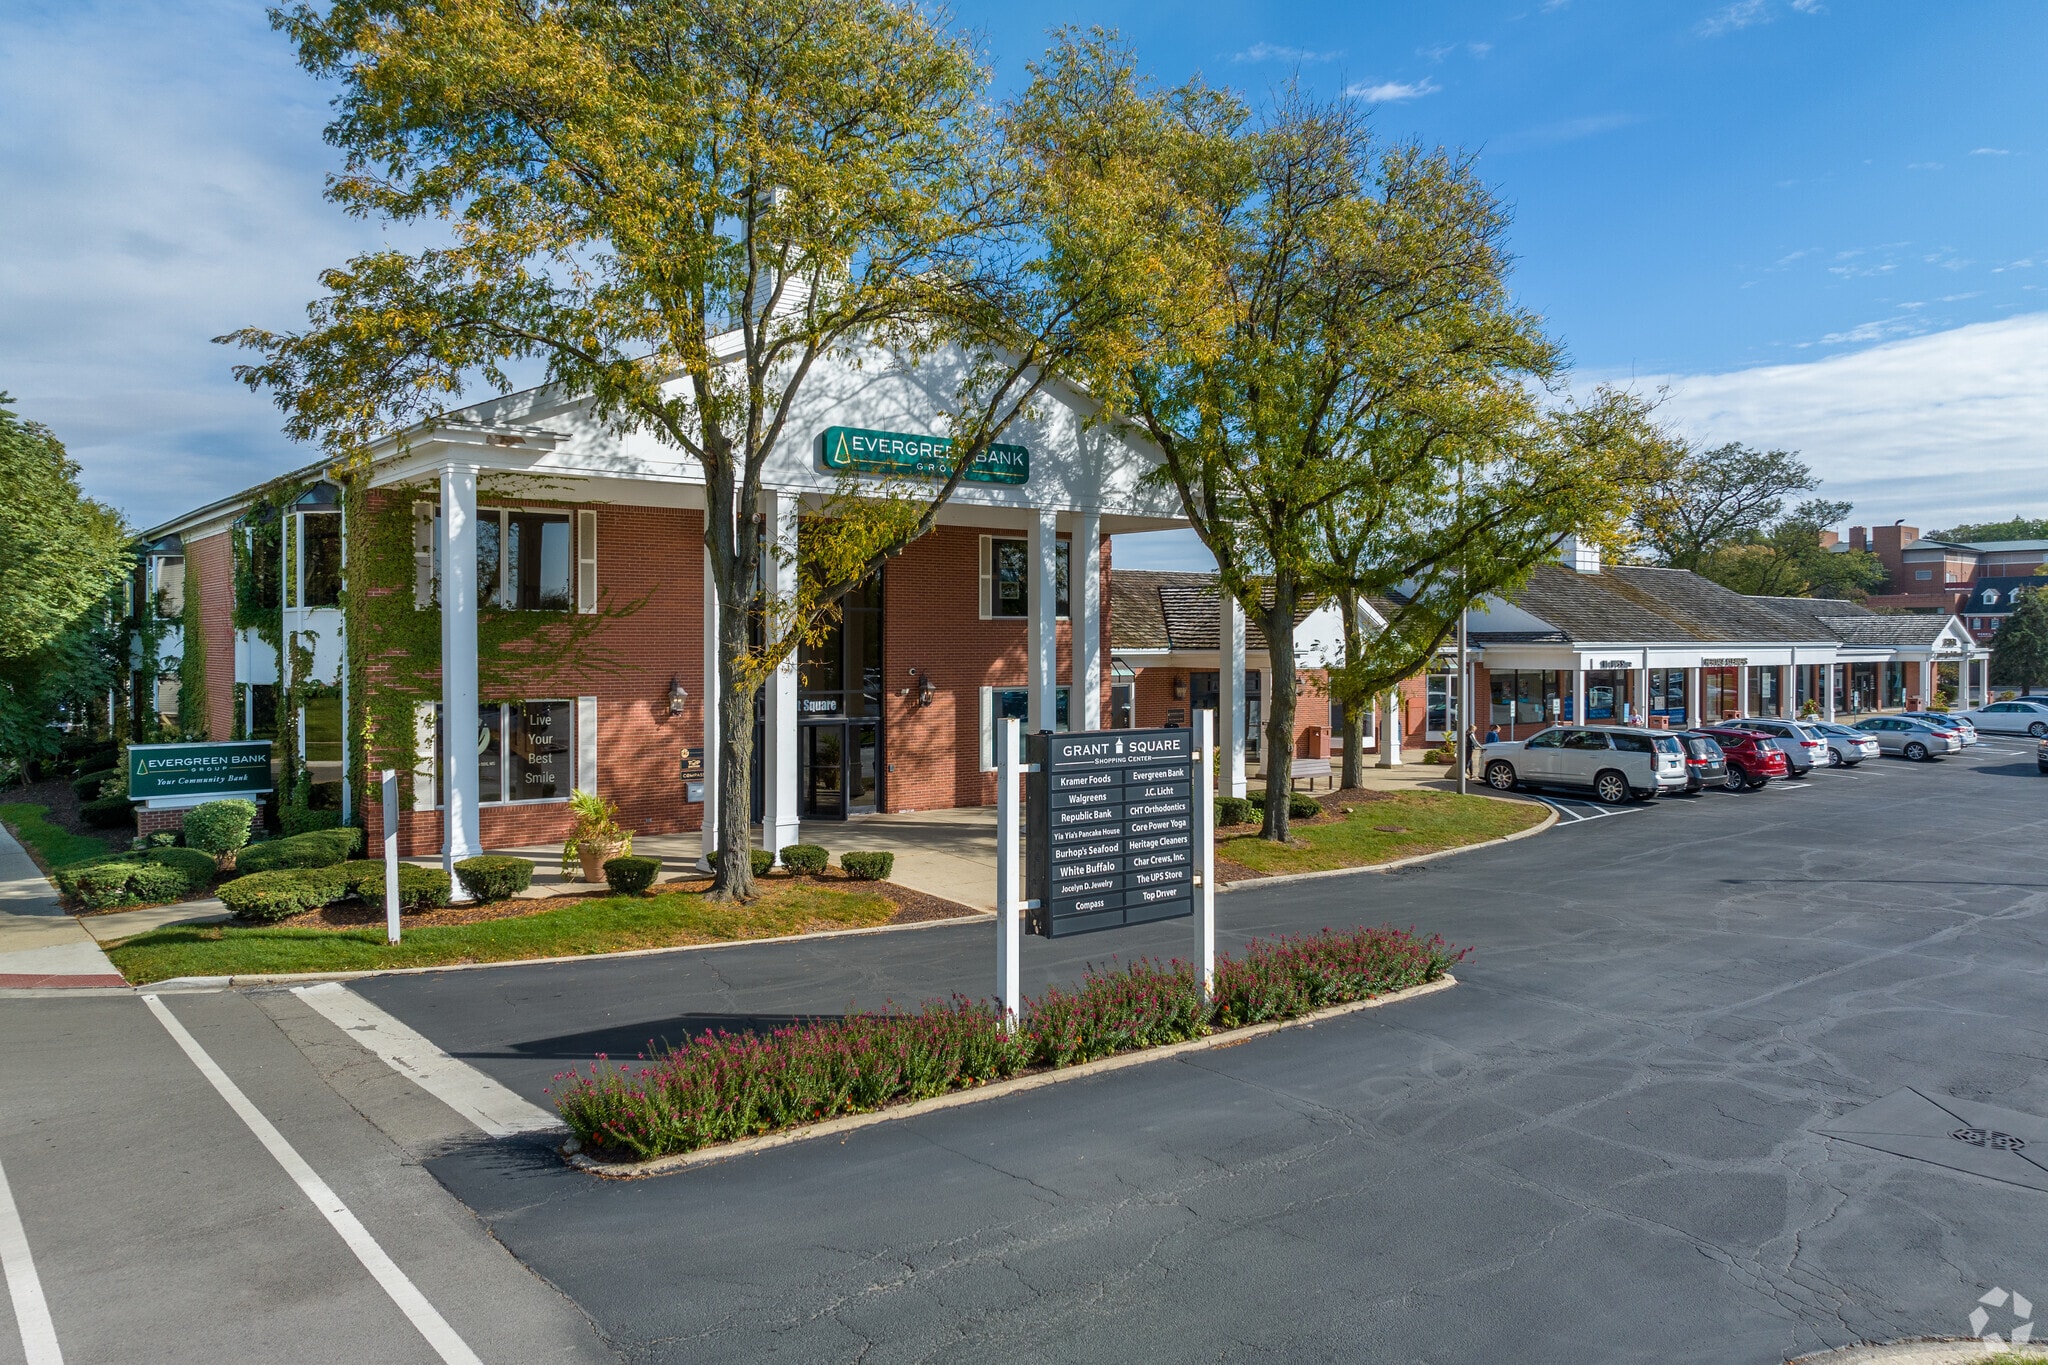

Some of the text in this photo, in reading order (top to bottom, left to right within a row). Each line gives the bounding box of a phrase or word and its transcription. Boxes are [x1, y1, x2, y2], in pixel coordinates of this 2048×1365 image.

[852, 435, 1024, 467] EVERGREE BANK
[916, 462, 969, 474] GRO
[803, 699, 837, 712] Square
[529, 713, 552, 726] Live
[528, 733, 553, 745] Your
[1062, 739, 1181, 756] GRANT SQUARE
[148, 754, 267, 768] EVERGREEN BANK
[528, 753, 553, 764] Best
[1094, 755, 1152, 765] SHOPPING CENTER
[157, 773, 249, 786] Your Community Bank
[525, 771, 555, 784] Smile
[1060, 774, 1112, 786] Kramer Foods
[1133, 768, 1184, 781] Evergreen Bank
[1144, 786, 1174, 797] J.C. Licht
[1068, 793, 1107, 805] Walgreens
[1061, 809, 1112, 823] Republic Bank
[1129, 803, 1186, 816] CHT Orthodontics
[1131, 819, 1187, 832] Core Power Yoga
[1078, 829, 1102, 838] Pancake
[1102, 828, 1121, 836] House
[1129, 836, 1188, 850] Heritage Cleaners
[1055, 843, 1119, 858] Burhop's Seafood
[1133, 853, 1185, 867] Char Crews, Inc.
[1060, 861, 1115, 877] White Buffalo
[1136, 871, 1183, 884] The UPS Store
[1061, 880, 1113, 893] Jocelyn D. Jewelry
[1142, 889, 1177, 901] Top Driver
[1075, 900, 1104, 910] Compass
